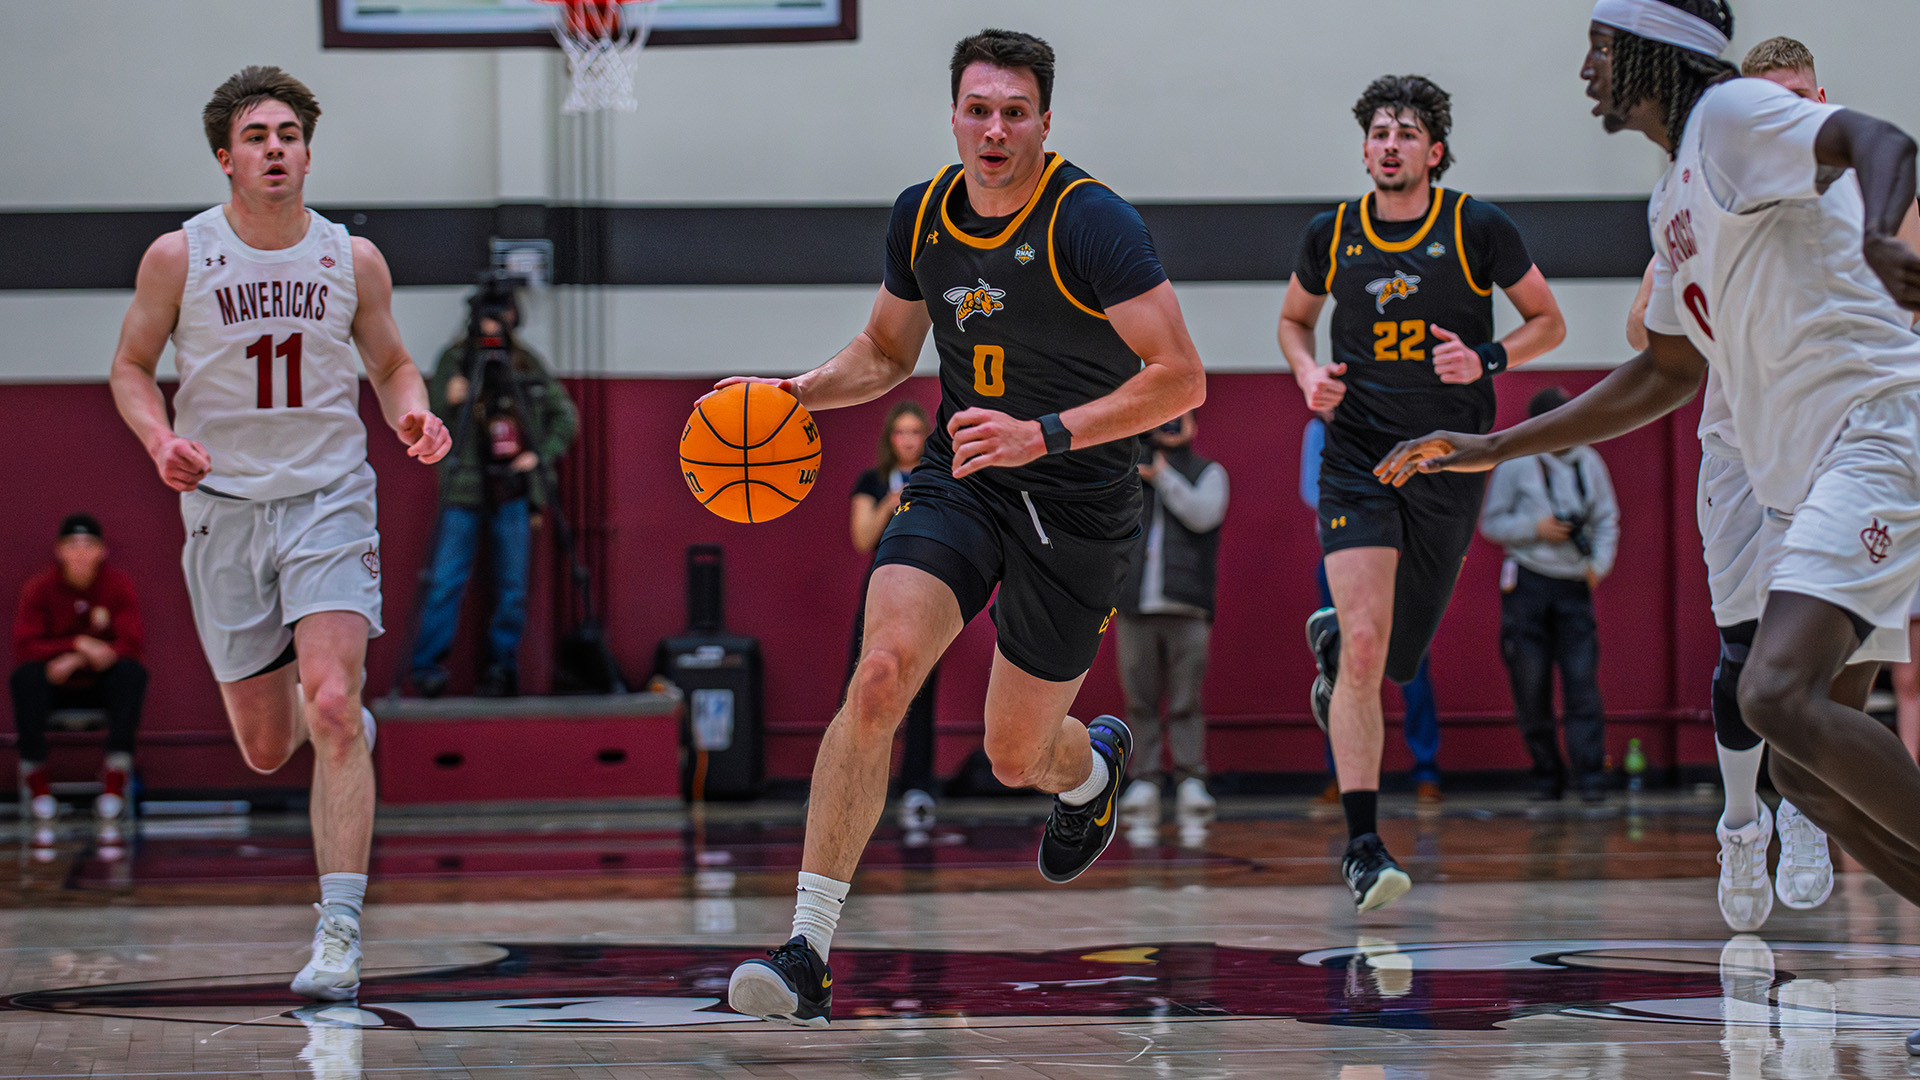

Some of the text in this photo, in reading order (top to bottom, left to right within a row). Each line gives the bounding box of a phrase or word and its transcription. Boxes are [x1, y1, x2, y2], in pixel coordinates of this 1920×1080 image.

[215, 281, 329, 326] MAVERICKS
[1373, 319, 1426, 361] 22
[246, 332, 303, 409] 11
[973, 344, 1005, 397] 0
